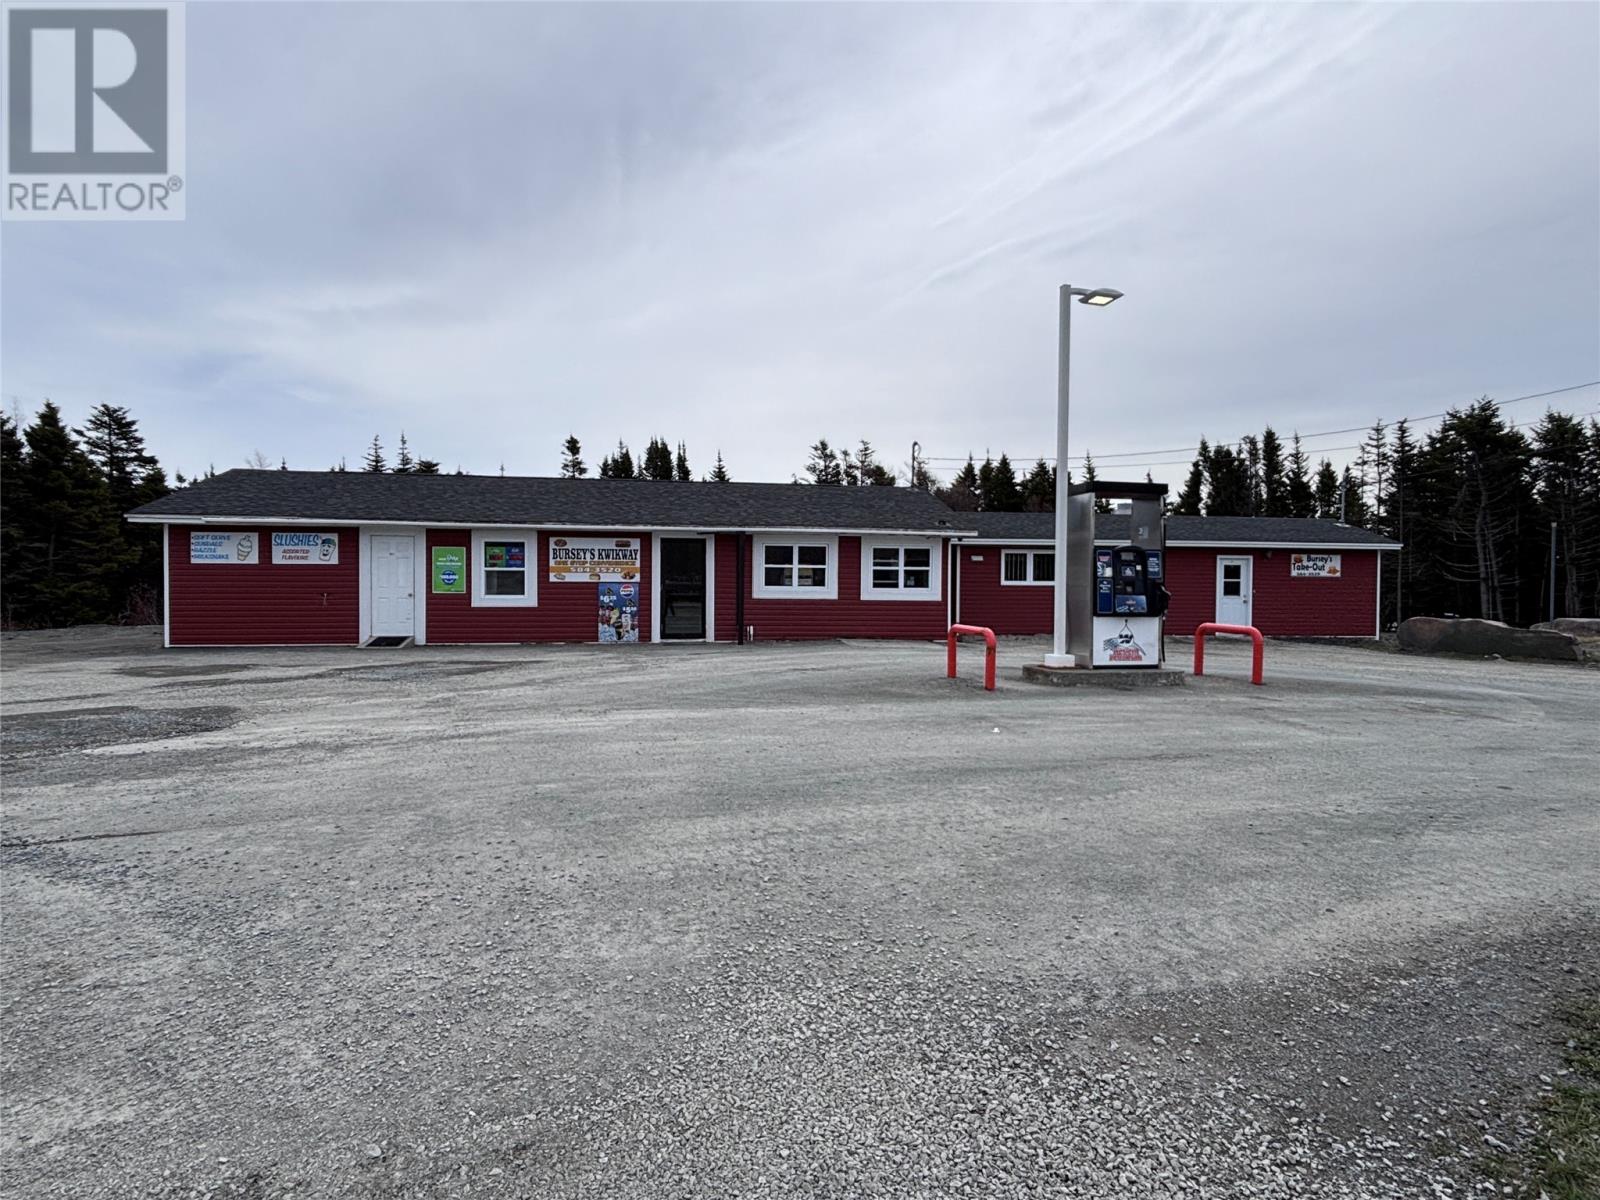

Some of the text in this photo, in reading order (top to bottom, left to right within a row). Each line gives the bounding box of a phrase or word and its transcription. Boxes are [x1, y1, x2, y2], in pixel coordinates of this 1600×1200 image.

[273, 533, 319, 546] SLUSHIES
[552, 548, 639, 561] BURSEY'S KWIKWAY
[1292, 563, 1326, 571] Take-Out
